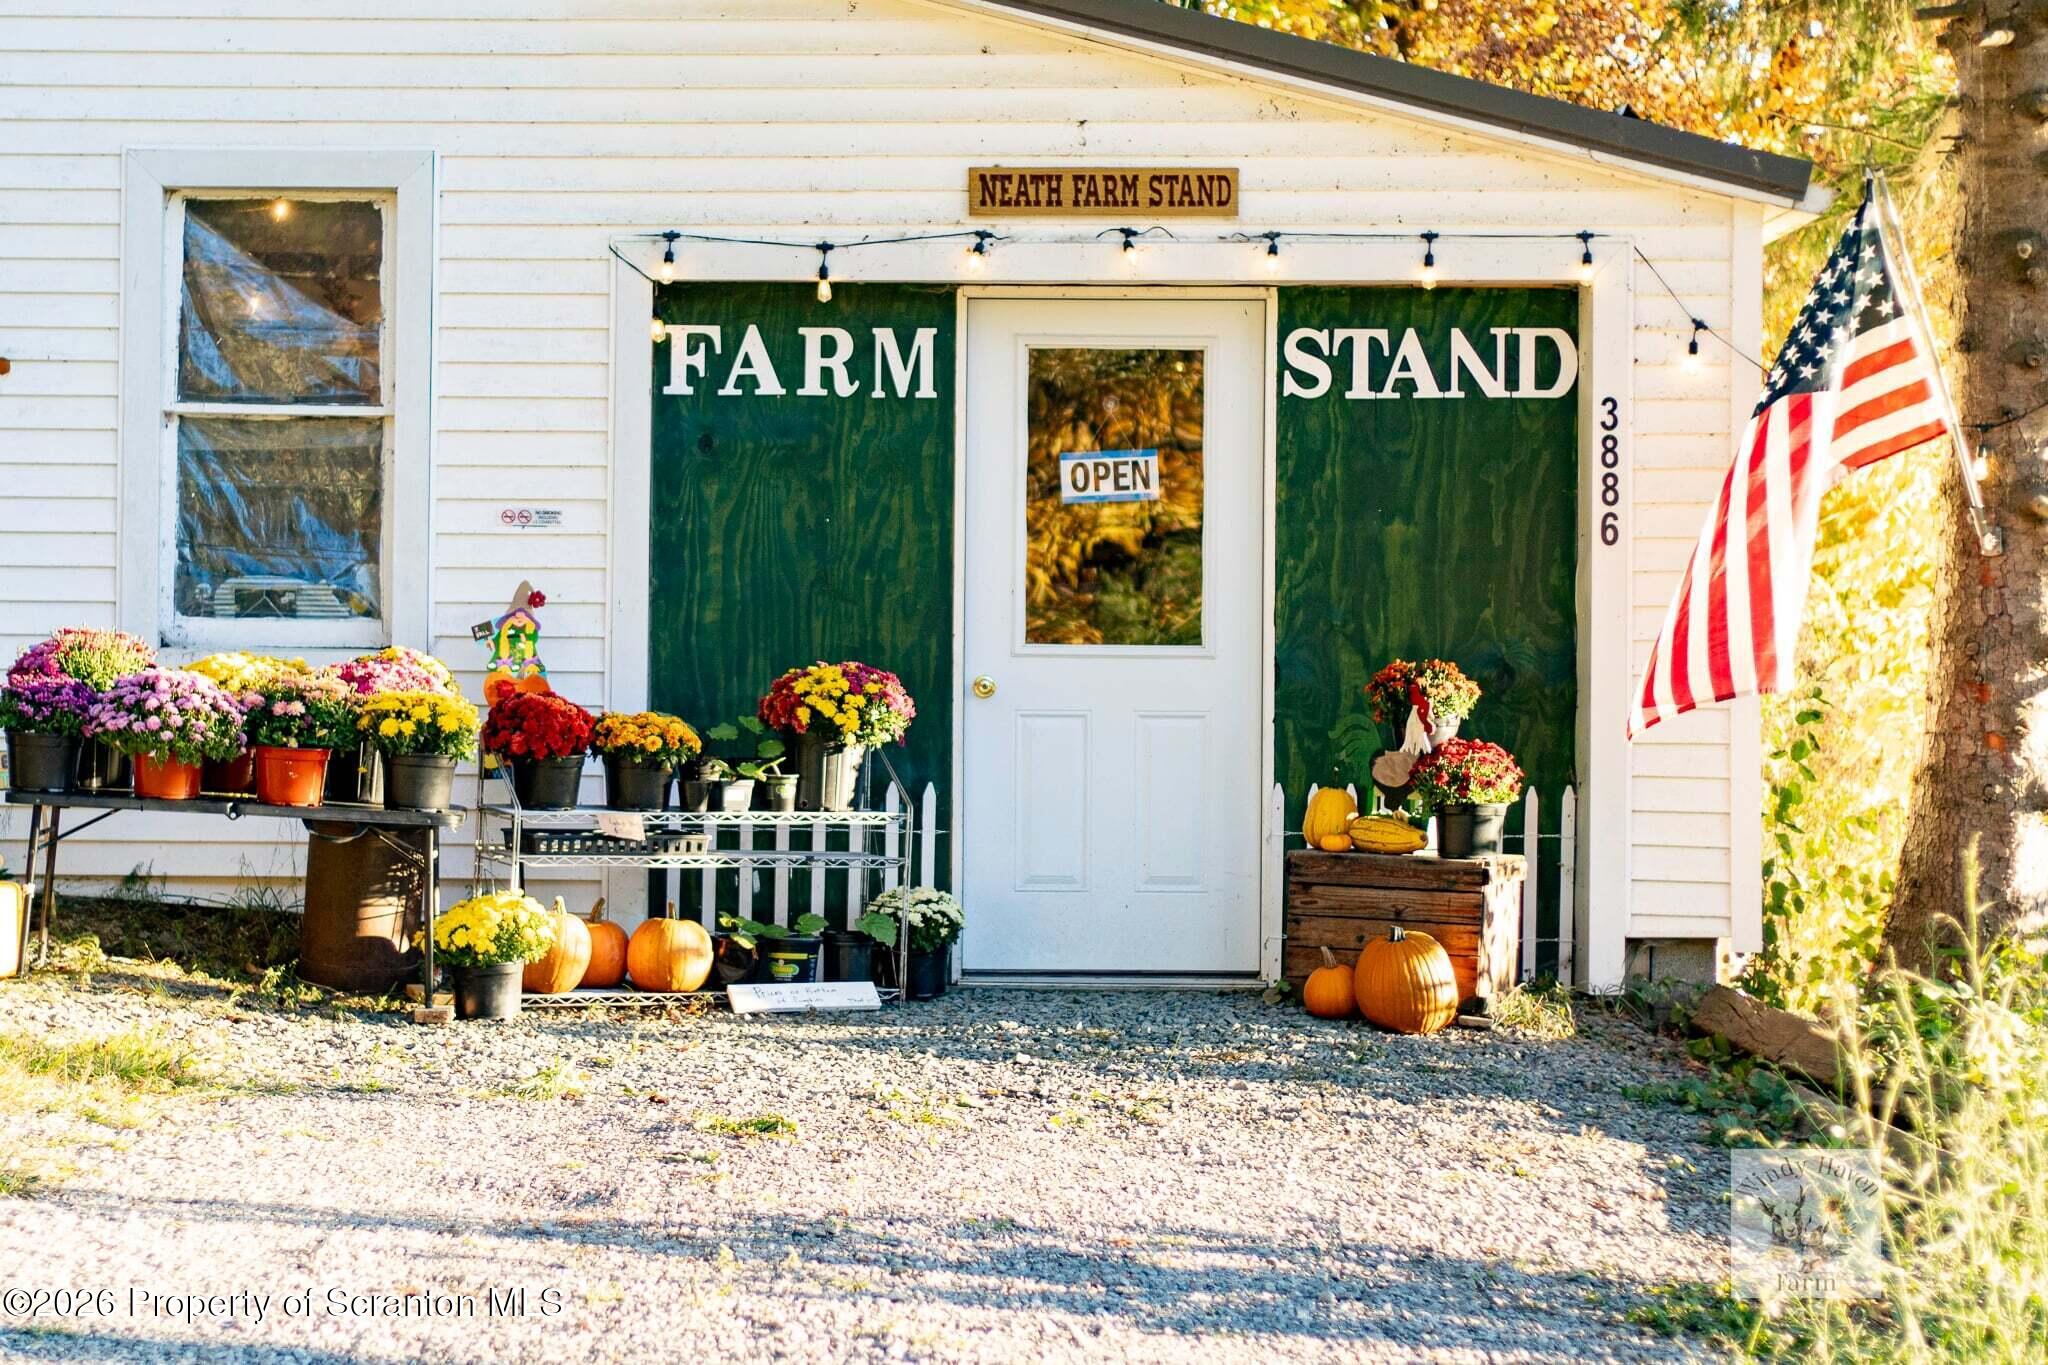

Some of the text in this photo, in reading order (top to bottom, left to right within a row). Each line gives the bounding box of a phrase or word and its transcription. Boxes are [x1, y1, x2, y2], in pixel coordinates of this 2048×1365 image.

[978, 173, 1232, 208] NEATH FARM STAND
[662, 323, 938, 399] FARM
[1282, 327, 1579, 400] STAND
[1070, 459, 1151, 493] OPEN
[1600, 396, 1619, 546] 3886
